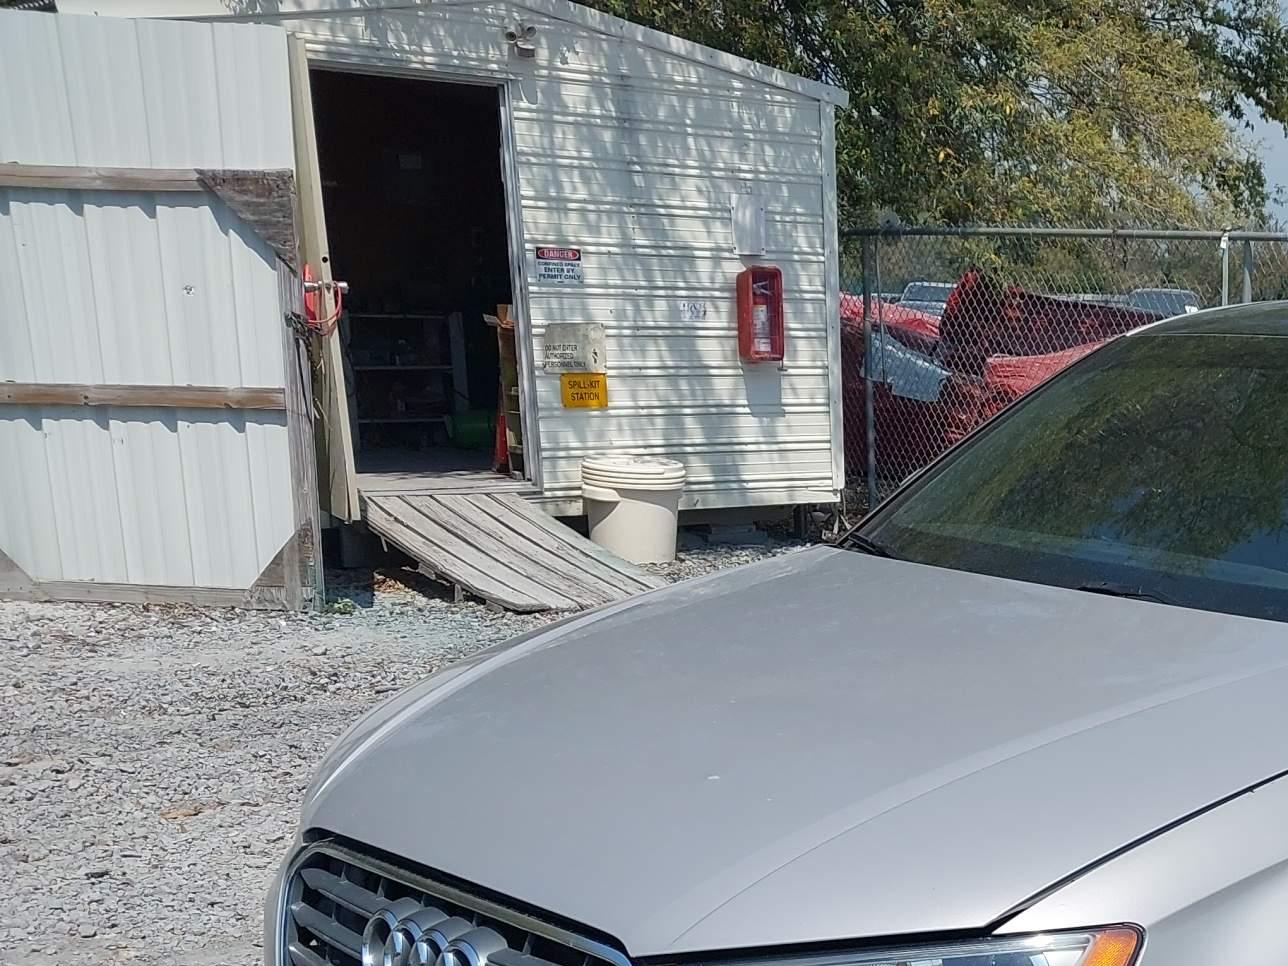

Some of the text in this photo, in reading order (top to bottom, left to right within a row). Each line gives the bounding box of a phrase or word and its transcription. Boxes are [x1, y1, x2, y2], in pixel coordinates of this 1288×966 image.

[544, 249, 573, 259] DANGER
[562, 344, 578, 352] ENTER
[545, 352, 574, 360] AUTHORIZED
[545, 360, 573, 368] PERSONNEL
[571, 392, 600, 401] STATION
